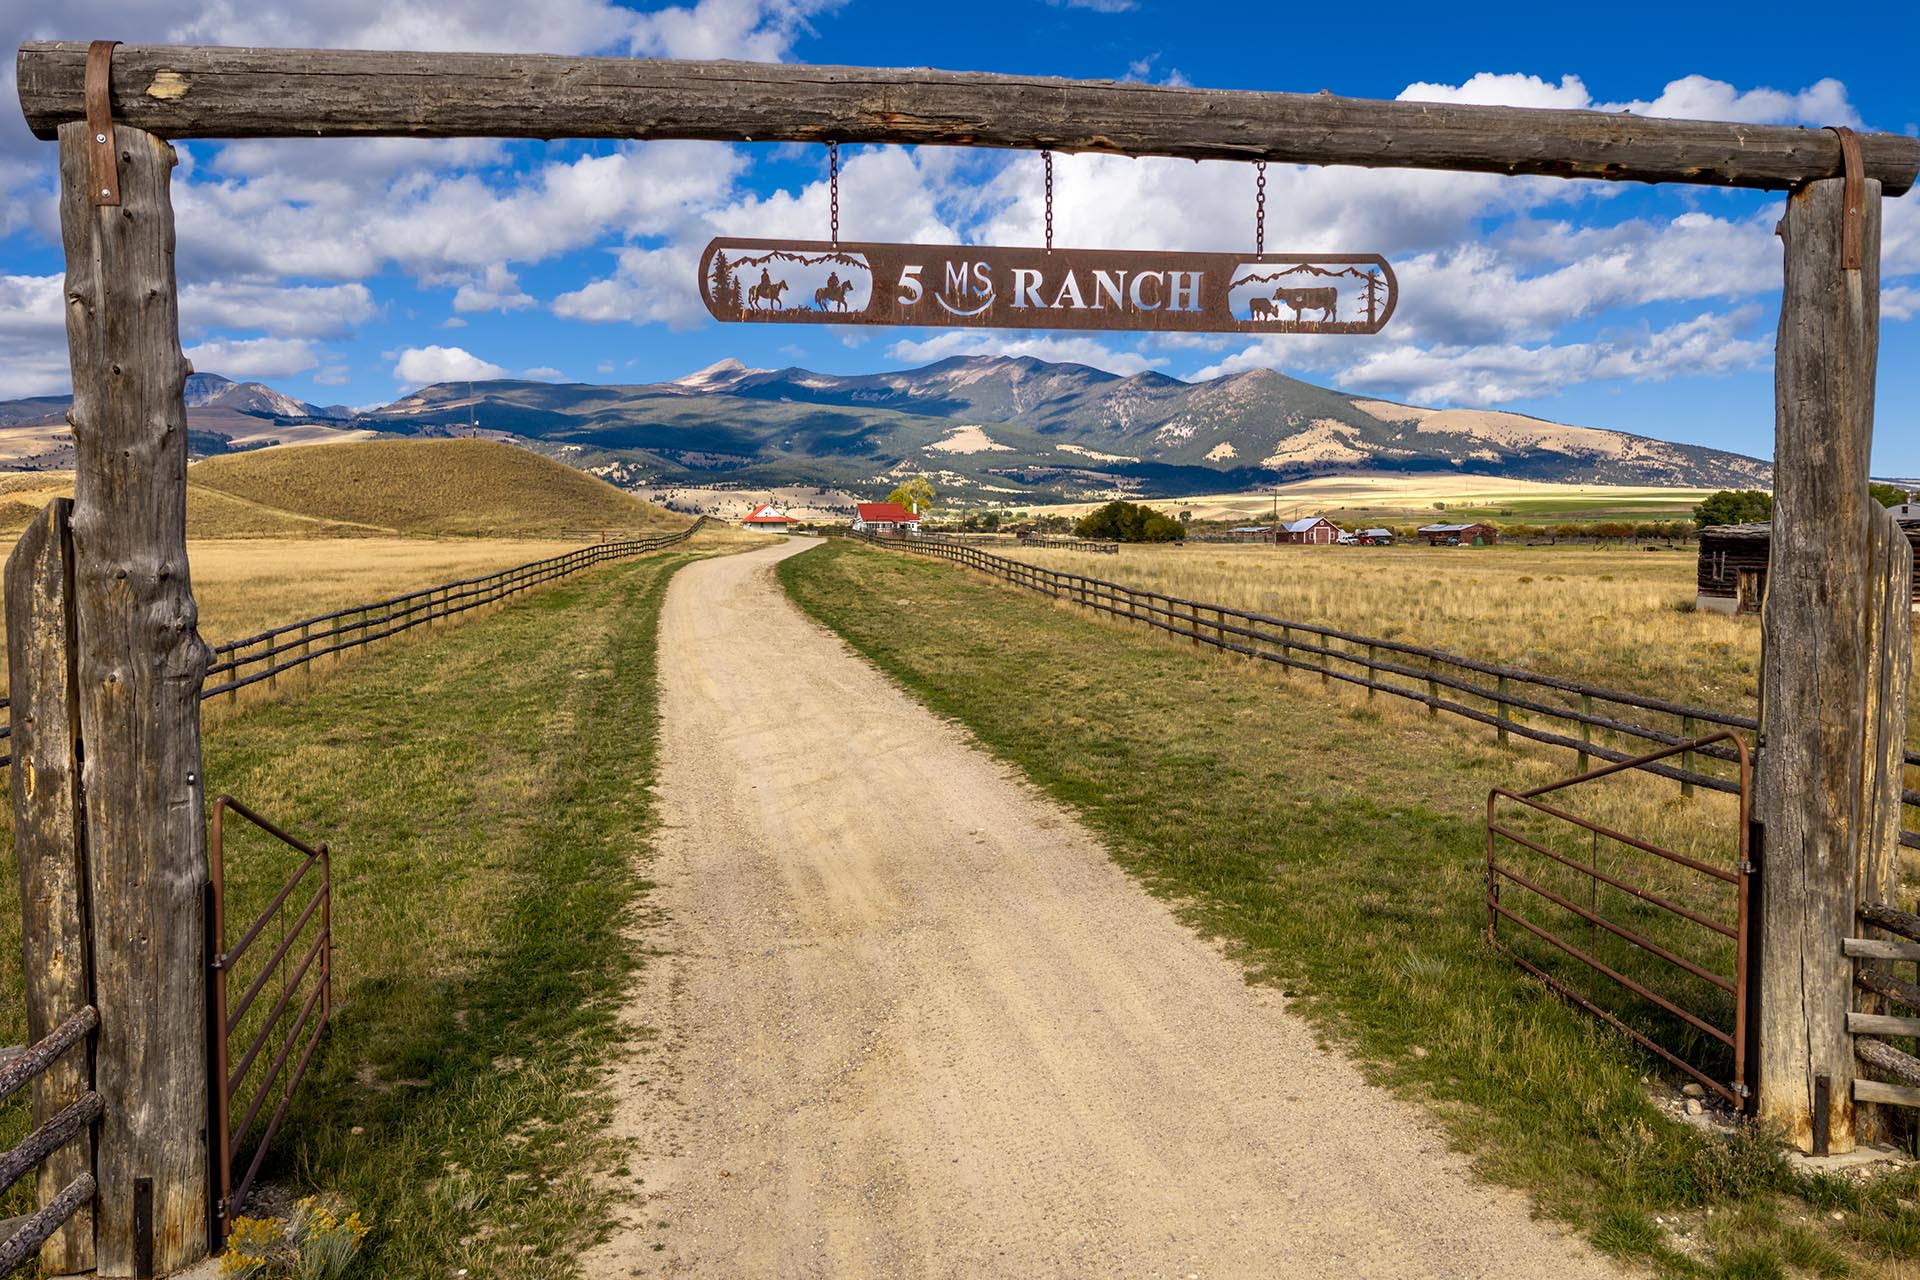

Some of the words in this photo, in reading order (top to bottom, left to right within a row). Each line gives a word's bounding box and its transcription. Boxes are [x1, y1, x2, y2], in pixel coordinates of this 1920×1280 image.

[898, 265, 923, 305] 5
[945, 260, 992, 297] MS
[1010, 268, 1205, 312] RANCH
